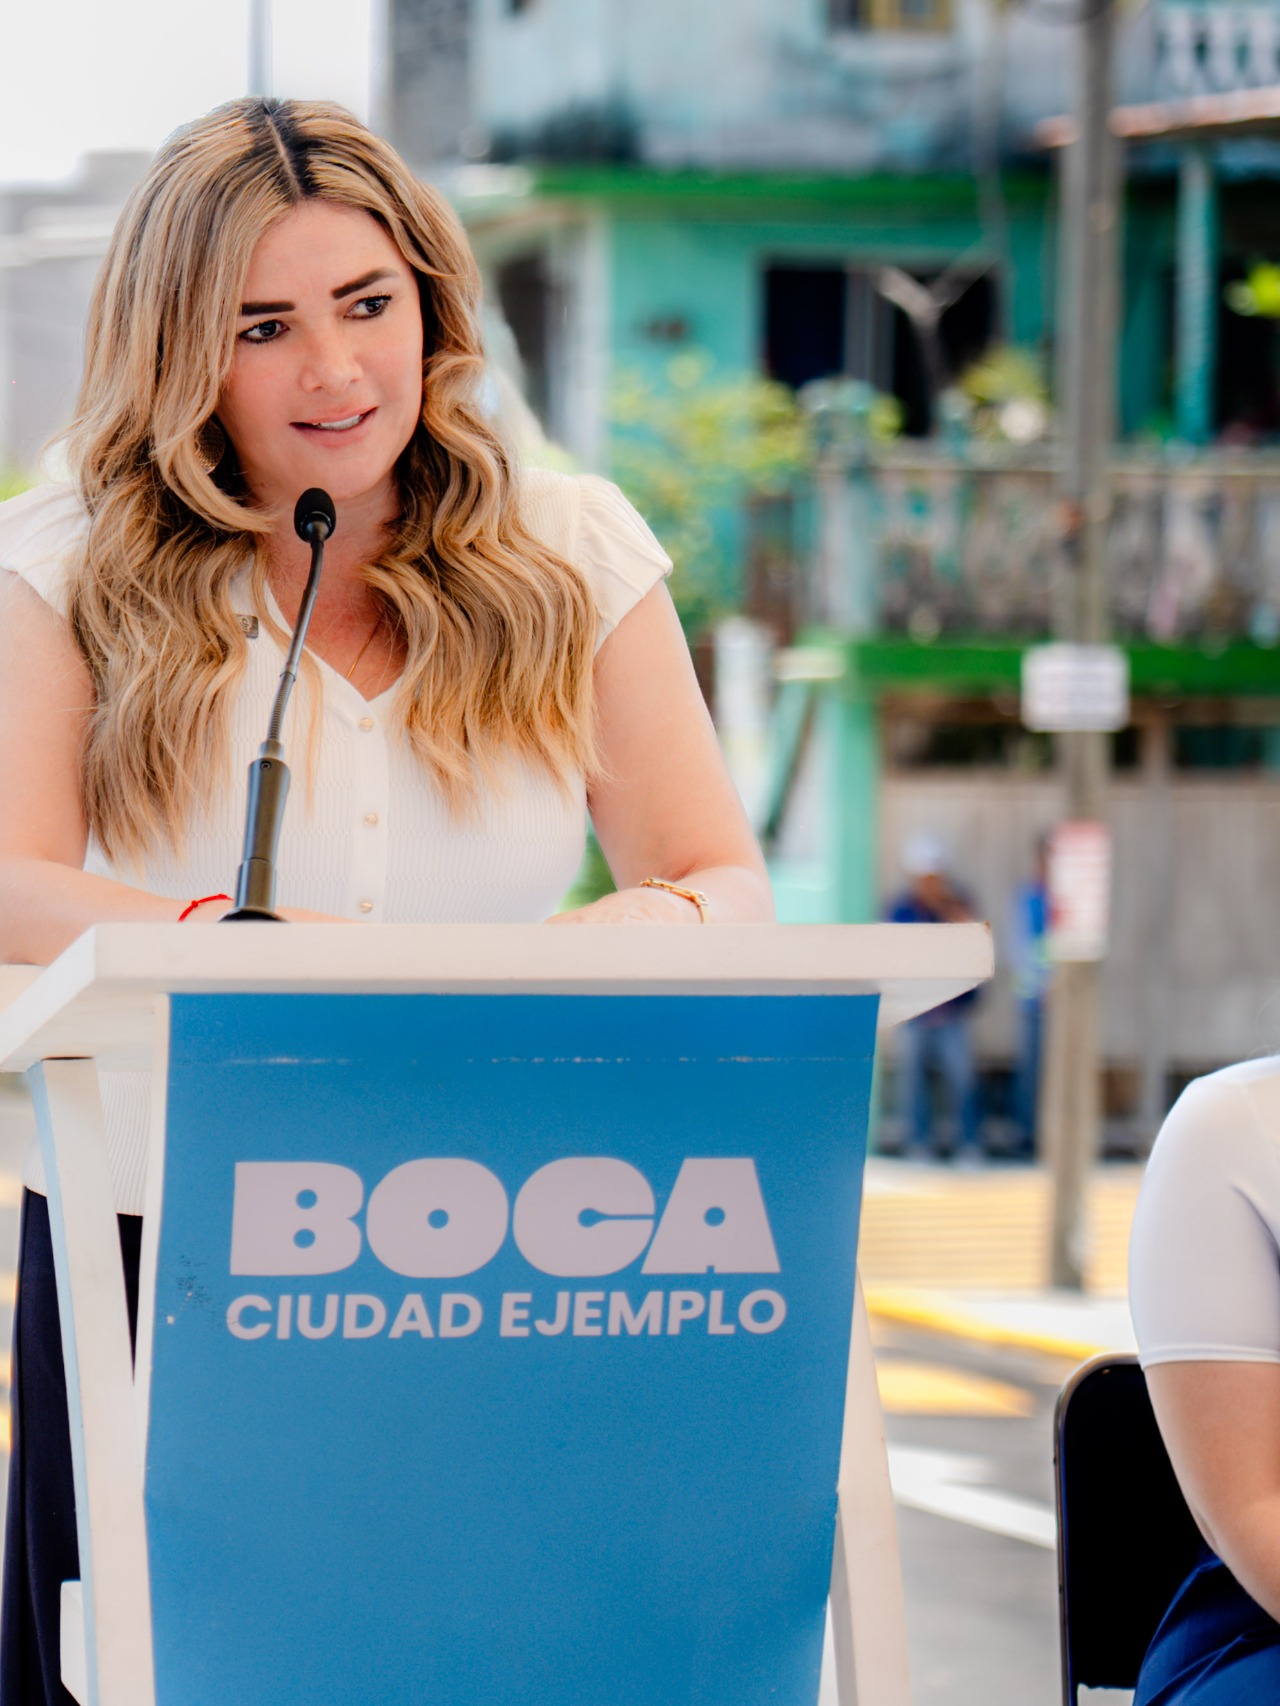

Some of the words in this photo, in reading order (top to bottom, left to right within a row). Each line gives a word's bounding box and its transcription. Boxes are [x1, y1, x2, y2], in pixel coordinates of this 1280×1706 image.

[230, 1157, 781, 1278] BOCA
[226, 1292, 483, 1340] CIUDAD
[500, 1289, 787, 1338] EJEMPLO
